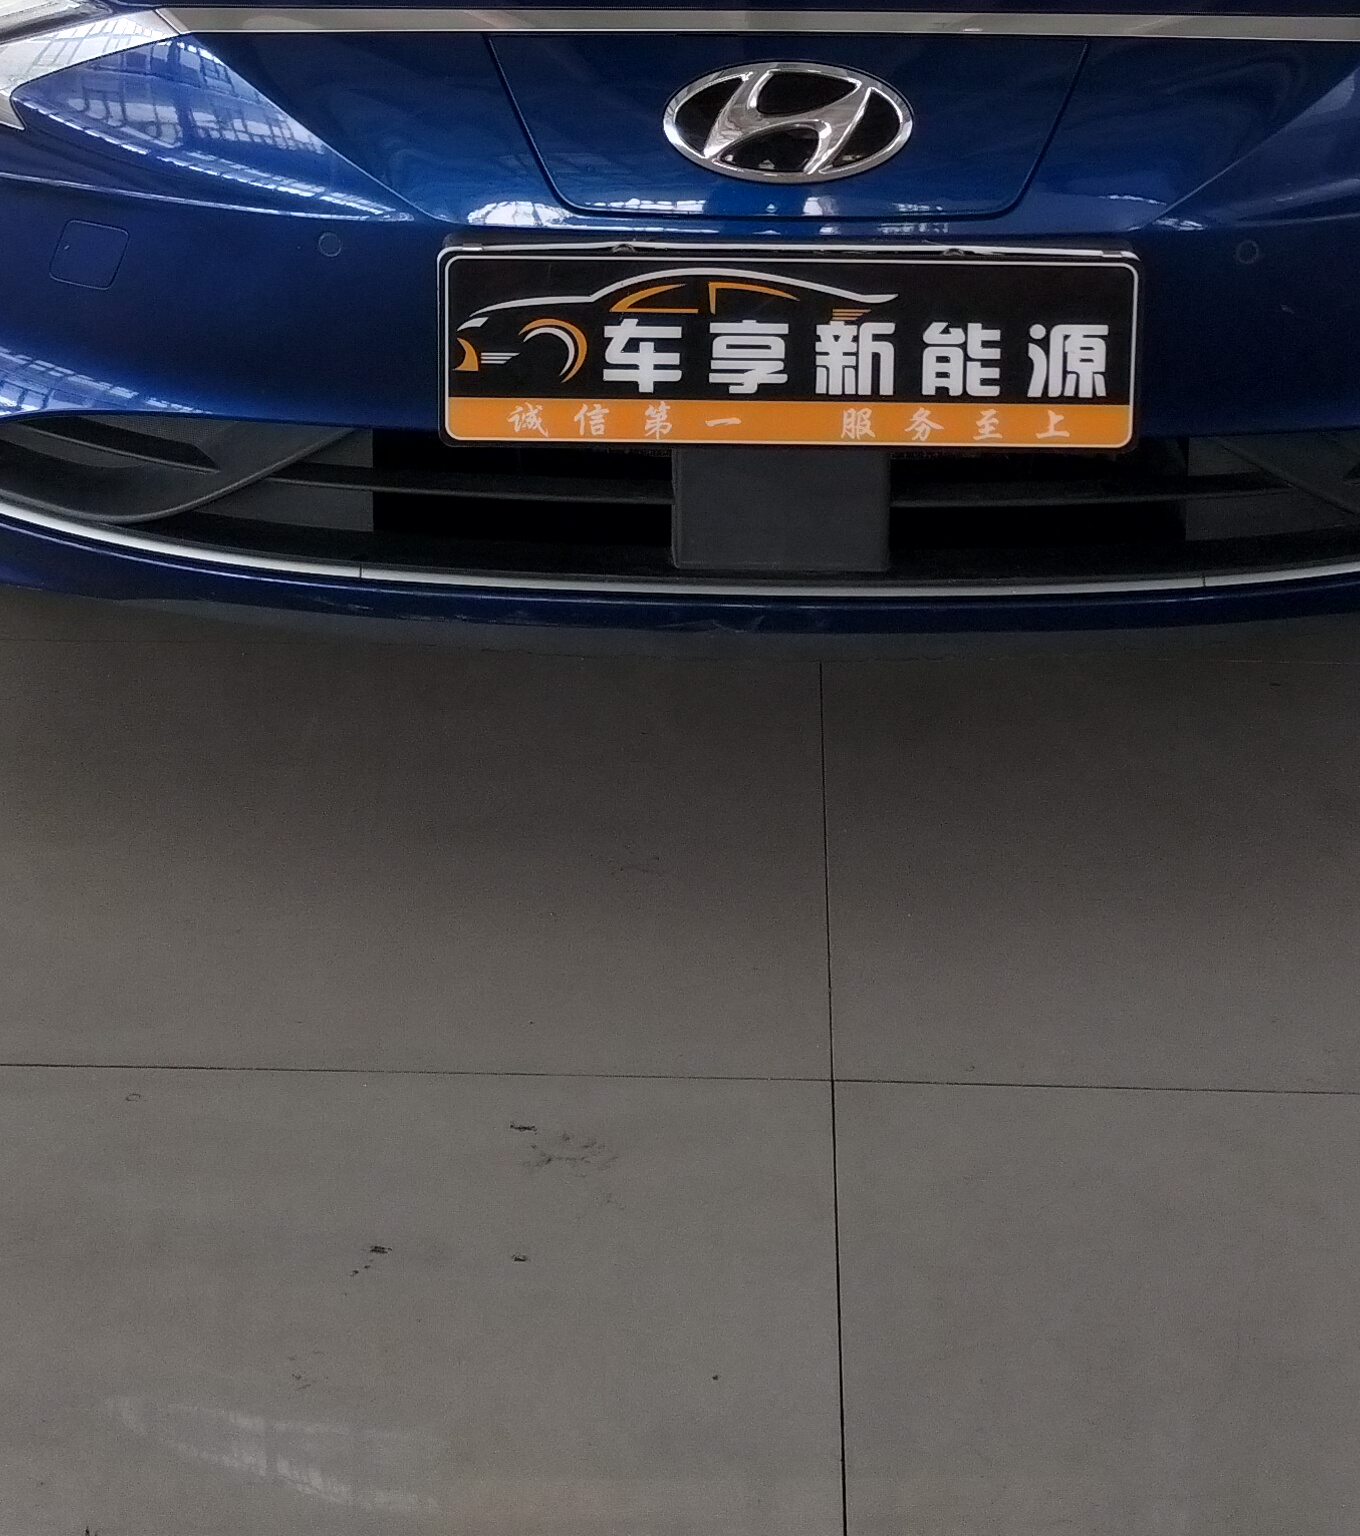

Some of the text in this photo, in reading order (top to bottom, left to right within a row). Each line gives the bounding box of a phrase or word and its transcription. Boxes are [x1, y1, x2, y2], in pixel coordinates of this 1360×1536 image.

[602, 318, 1110, 398] 车享新能源
[506, 403, 1071, 443] 诚信第一 服务至上
